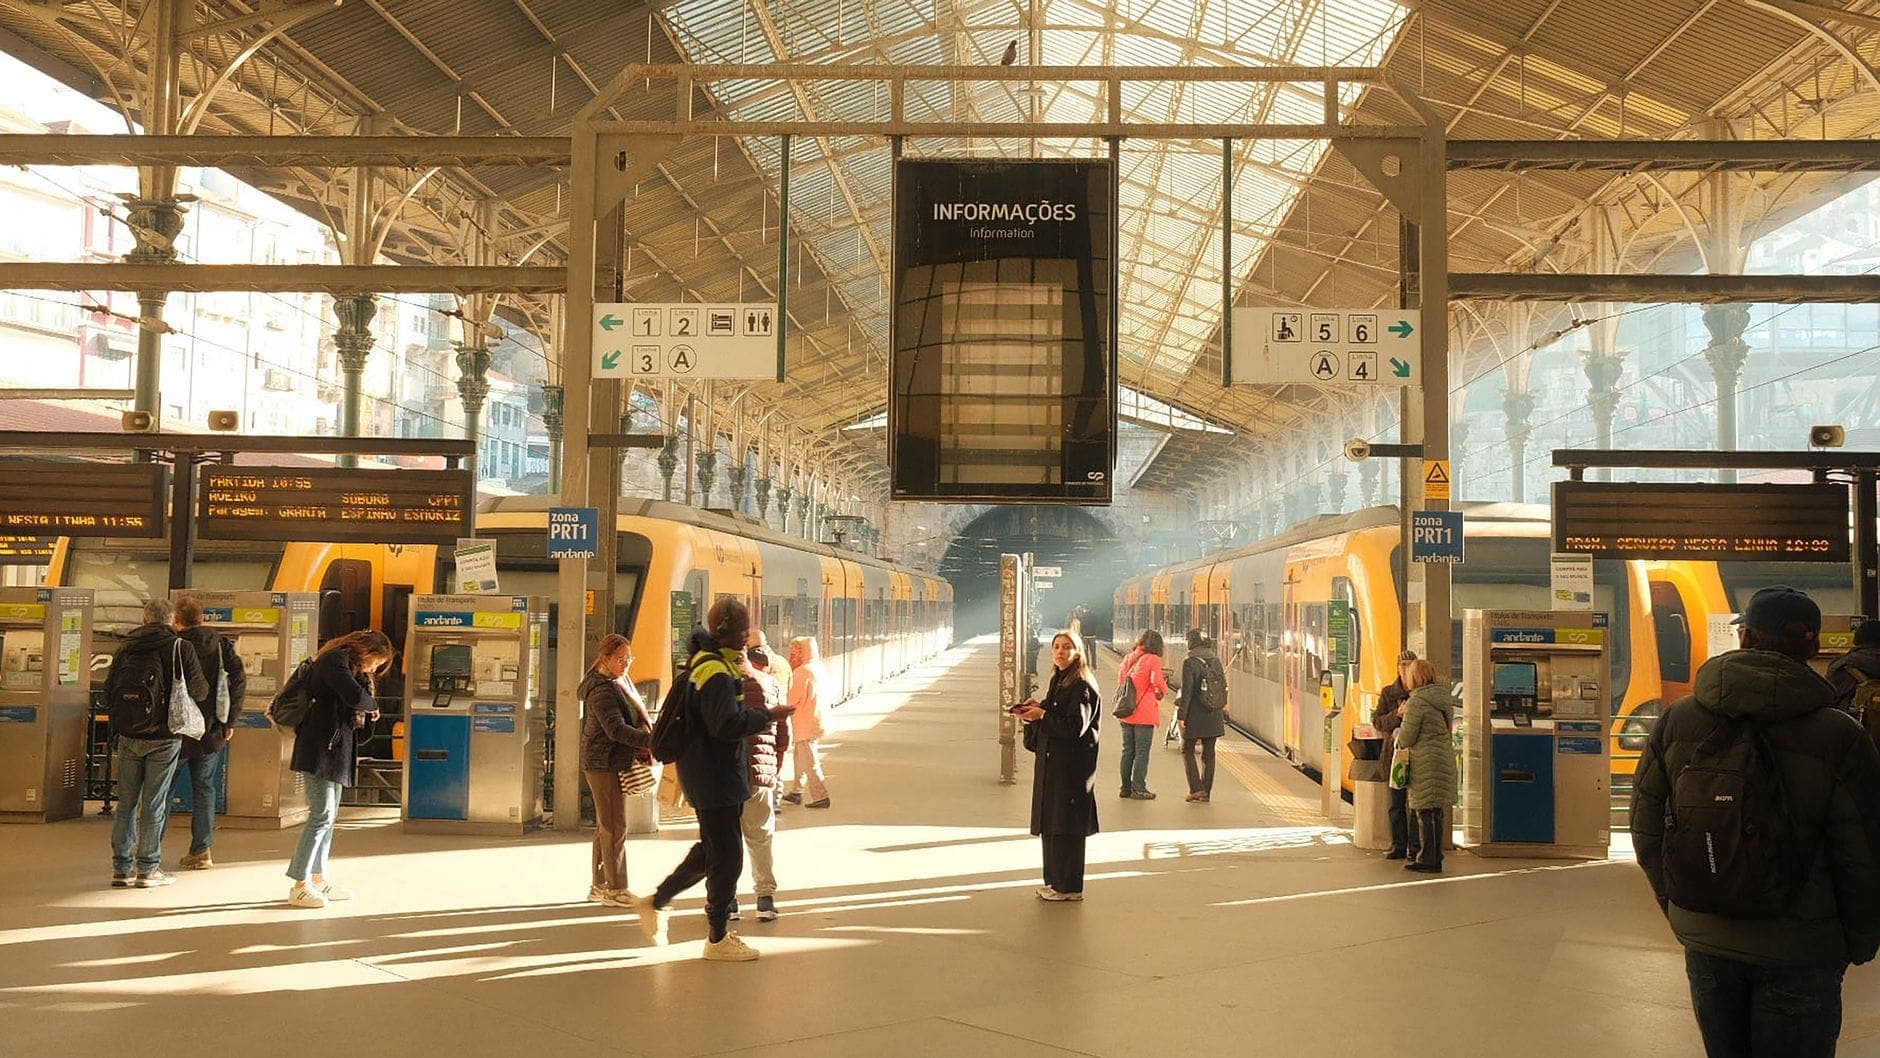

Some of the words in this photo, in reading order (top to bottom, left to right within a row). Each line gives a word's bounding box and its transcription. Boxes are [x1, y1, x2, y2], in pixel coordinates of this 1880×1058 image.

[933, 200, 1076, 225] INFORMAÇÕES
[970, 227, 1035, 239] Information
[643, 317, 651, 335] 1
[678, 317, 690, 335] 2
[1319, 324, 1331, 341] 5
[1355, 325, 1368, 342] 6
[641, 354, 653, 372] 3
[673, 351, 690, 368] A
[1316, 357, 1333, 374] A
[1355, 361, 1368, 379] 4
[209, 475, 265, 488] PARTIDA
[8, 515, 49, 525] NESTA
[103, 516, 143, 527] 11:55
[551, 513, 579, 522] zona
[1414, 517, 1443, 526] zona
[551, 523, 587, 540] PRT1
[1414, 527, 1452, 544] PRT1
[550, 548, 595, 559] andante
[1415, 553, 1461, 563] andante
[423, 615, 463, 625] andante
[1503, 632, 1544, 643] andante
